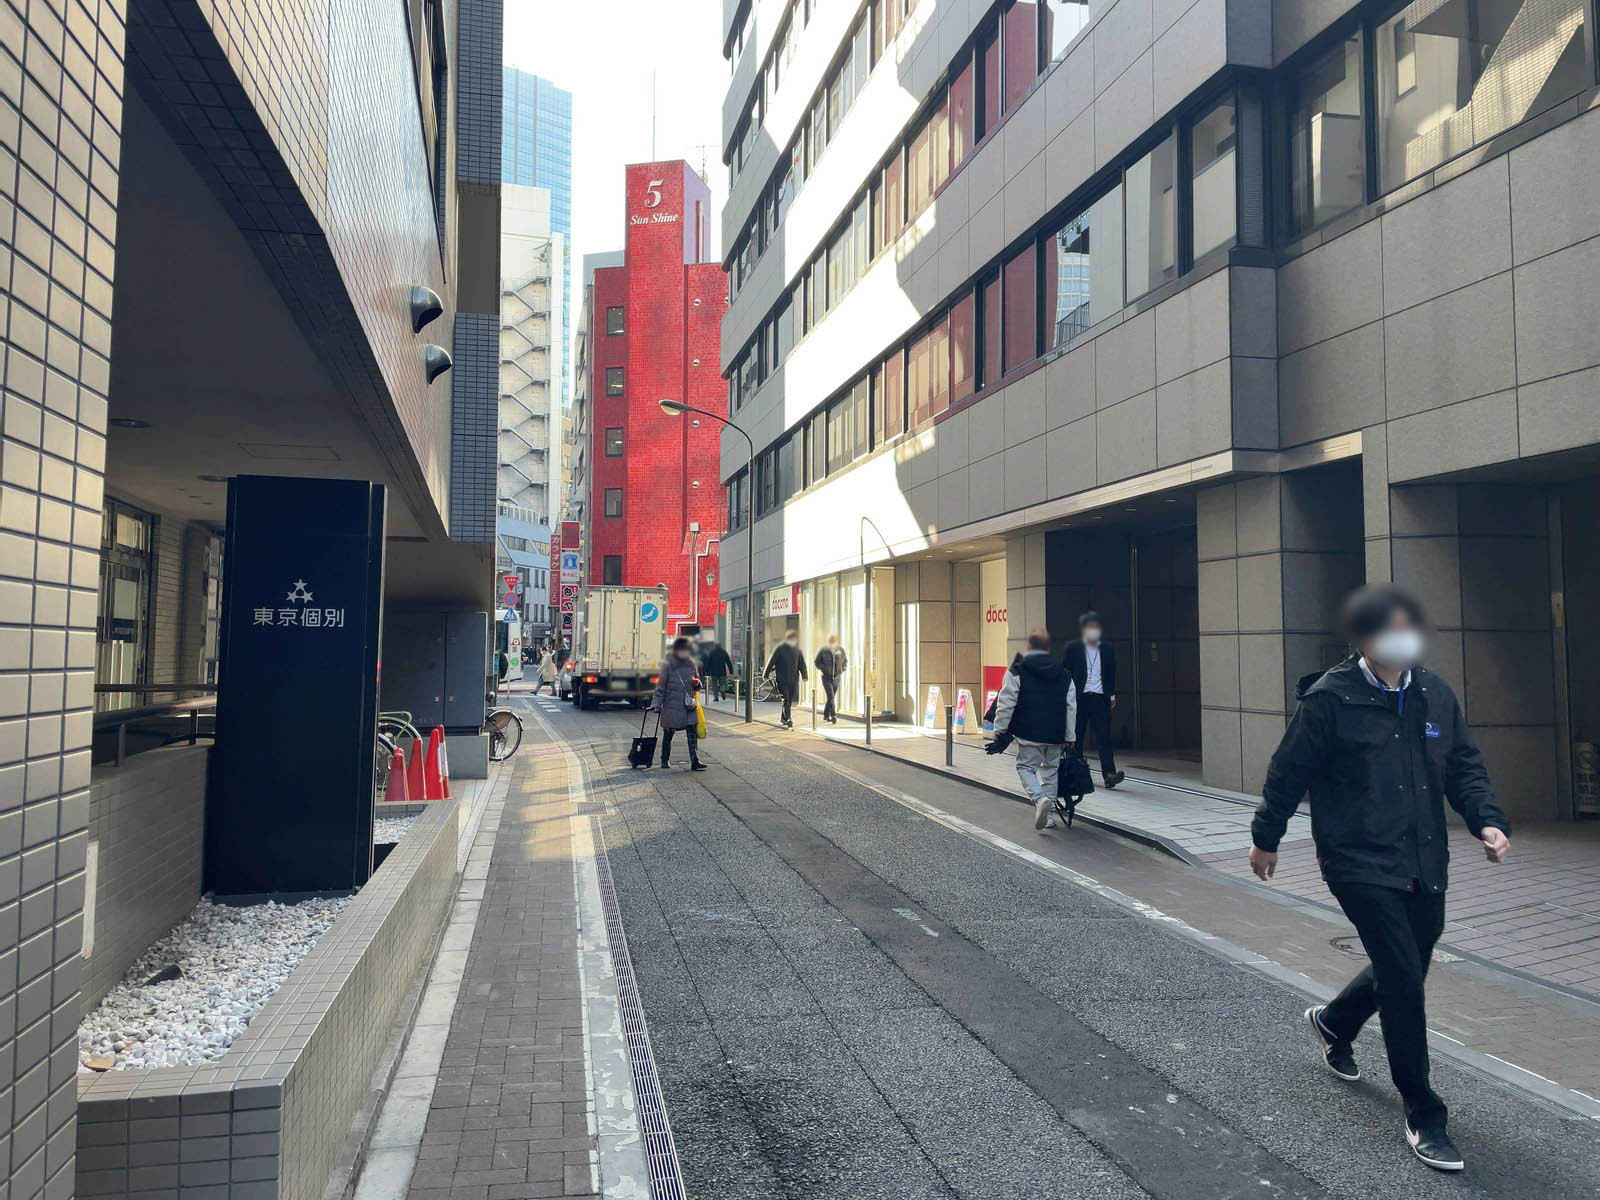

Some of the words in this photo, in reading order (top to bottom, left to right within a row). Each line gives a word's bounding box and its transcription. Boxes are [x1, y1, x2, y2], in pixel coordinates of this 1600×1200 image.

[644, 178, 664, 208] 5
[630, 215, 649, 225] Sun
[651, 212, 679, 224] Shine
[252, 607, 345, 628] 東京個別
